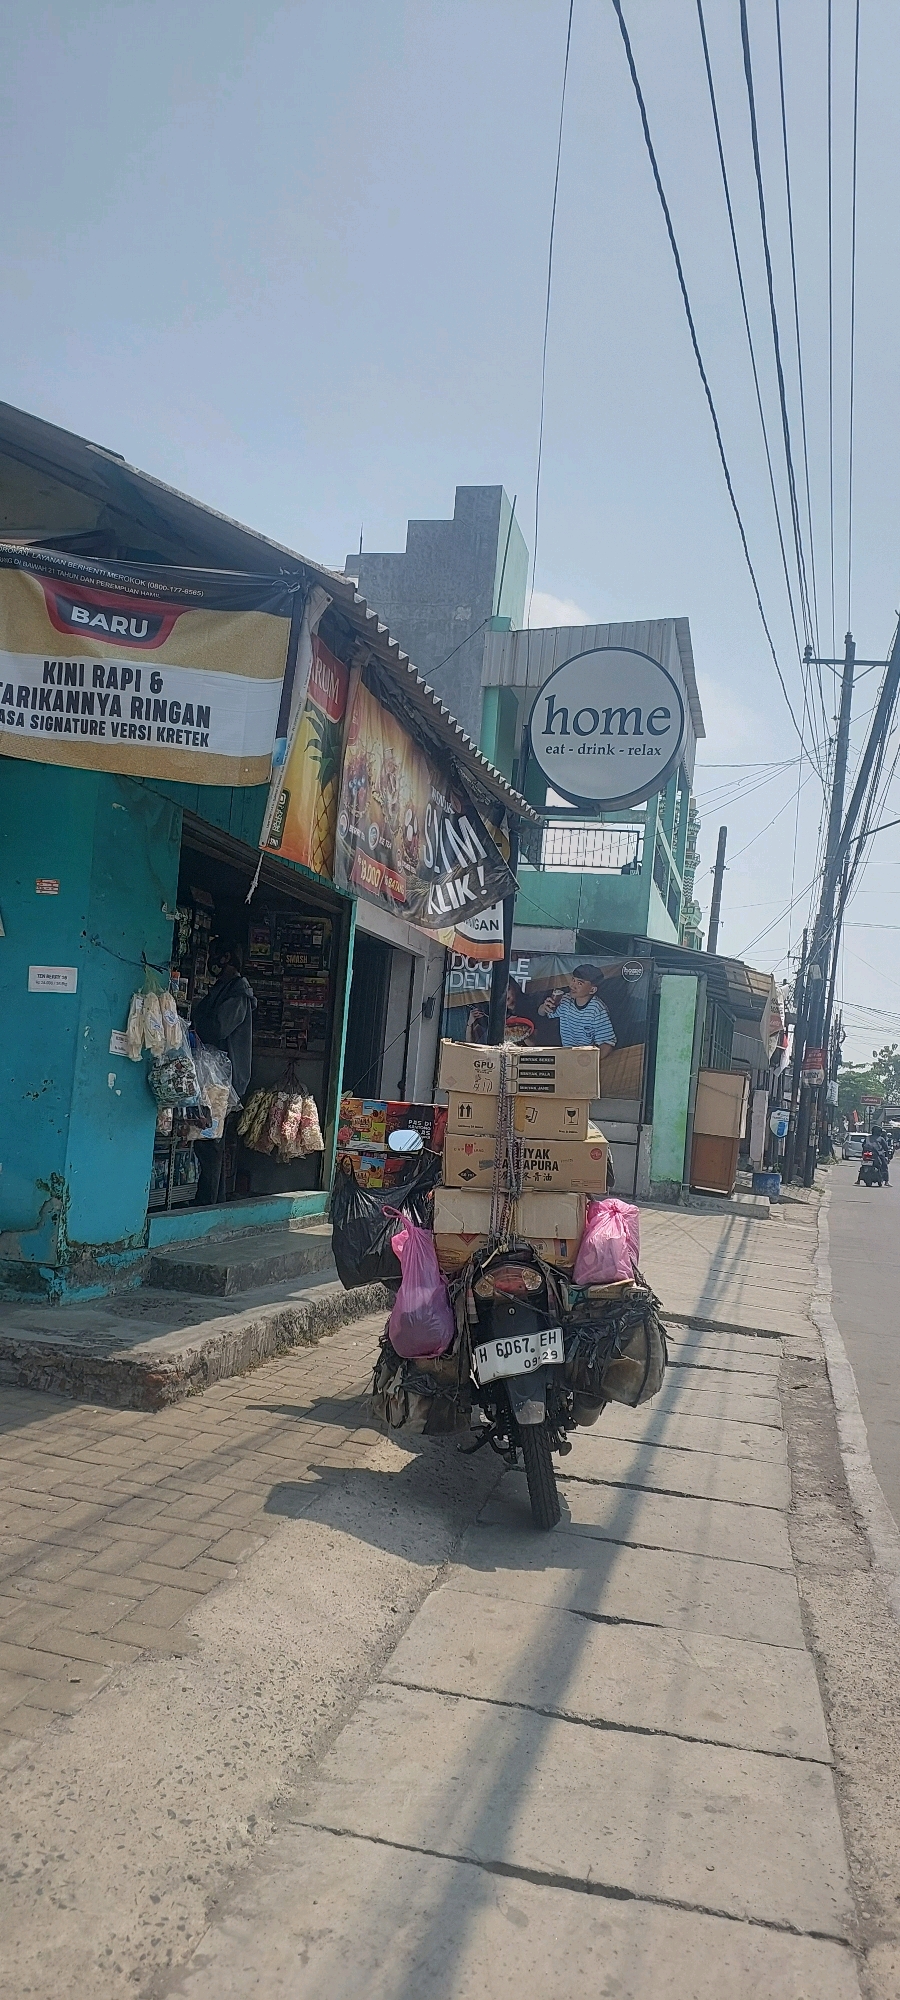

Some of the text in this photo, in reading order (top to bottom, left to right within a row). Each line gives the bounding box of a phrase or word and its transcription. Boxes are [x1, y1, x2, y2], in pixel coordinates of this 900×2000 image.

[22, 561, 47, 572] BAWAH
[57, 569, 79, 581] TAHUN
[79, 575, 95, 585] DAN
[96, 579, 139, 595] PEREMPUAN
[32, 552, 67, 566] LAYANAN
[67, 561, 106, 577] BERHENTI
[106, 571, 147, 587] MEROKOK
[70, 606, 149, 638] BARU
[42, 660, 163, 694] KINI RAPI &
[130, 695, 211, 729] RINGAN
[541, 694, 671, 737] home
[30, 714, 106, 737] SIGNATURE
[110, 721, 152, 742] VERSI
[156, 726, 210, 748] KRETEK
[545, 743, 566, 755] eat
[577, 743, 616, 756] drink
[627, 743, 662, 756] relax
[473, 1060, 494, 1069] GPU
[479, 1331, 557, 1363] H 6067 EH
